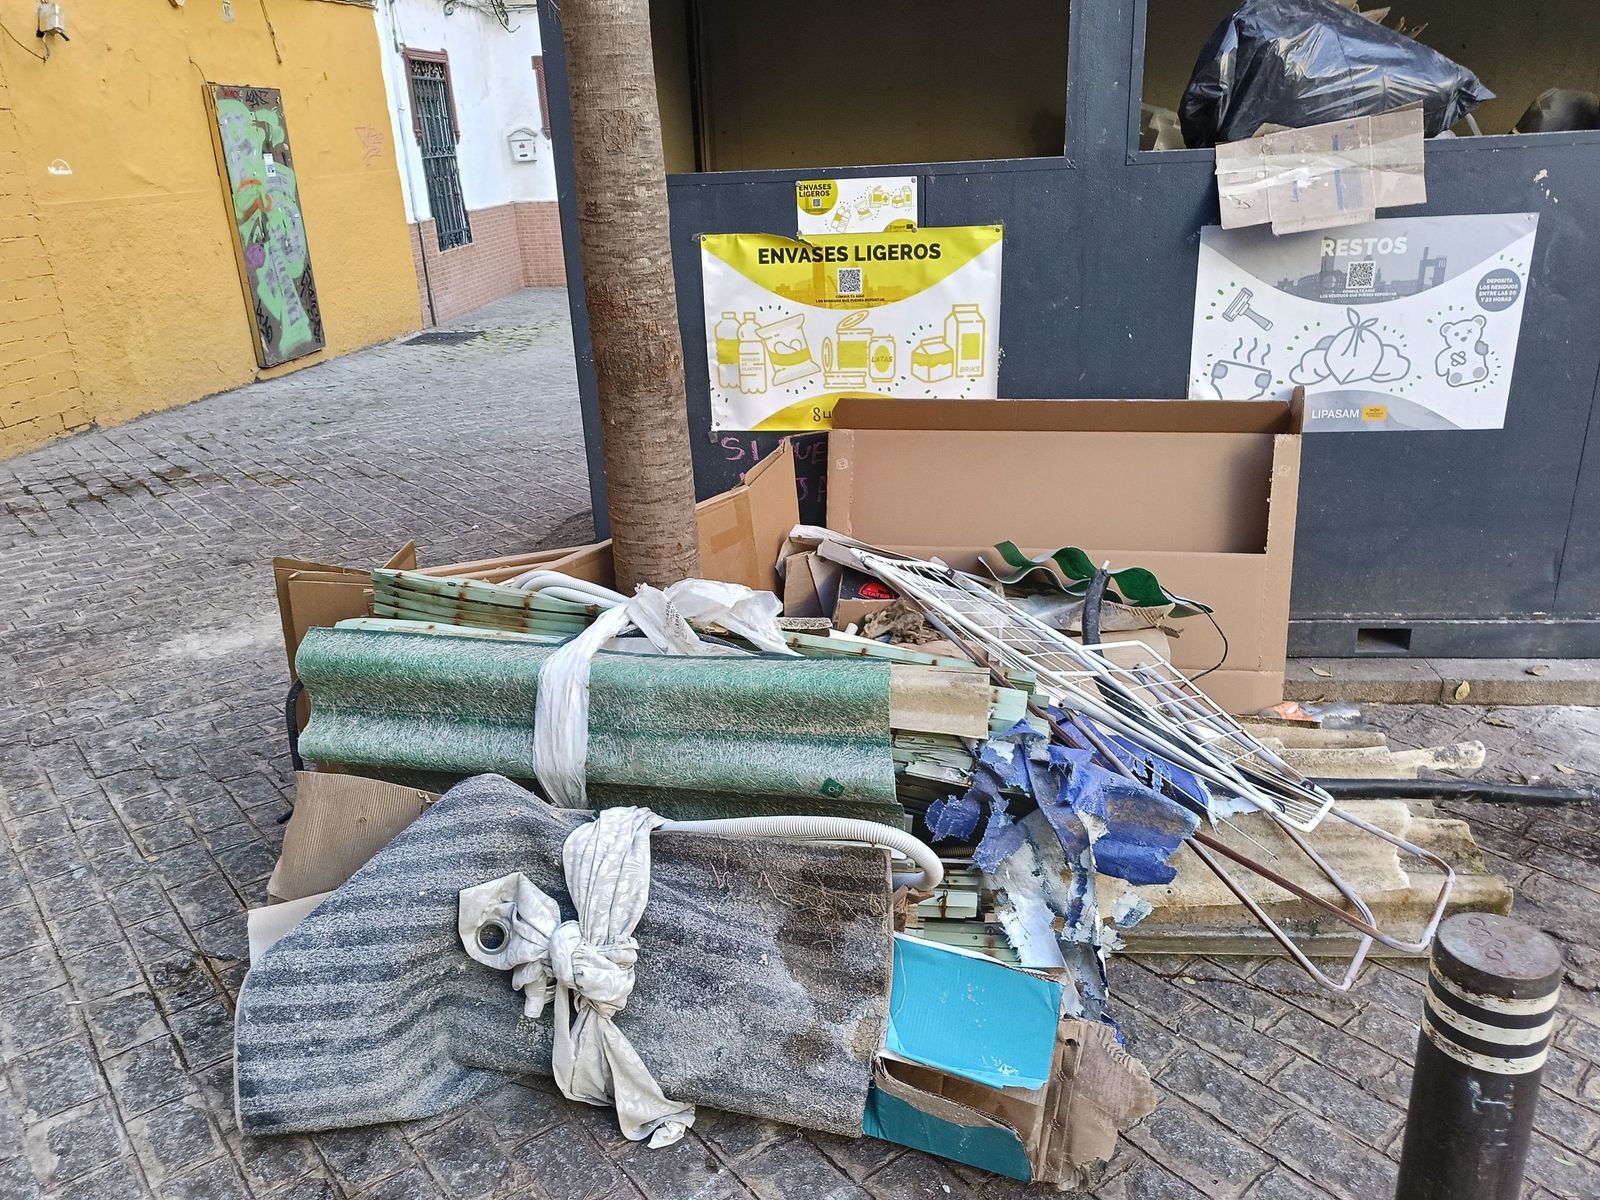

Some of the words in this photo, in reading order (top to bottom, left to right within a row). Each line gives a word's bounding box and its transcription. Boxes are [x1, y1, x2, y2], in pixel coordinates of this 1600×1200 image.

[1321, 237, 1408, 256] RESTOS
[758, 246, 849, 264] ENVASES
[854, 243, 941, 262] LIGEROS
[871, 355, 893, 363] LATAS
[959, 365, 981, 373] BRIKS
[1311, 408, 1359, 419] LIPASAM
